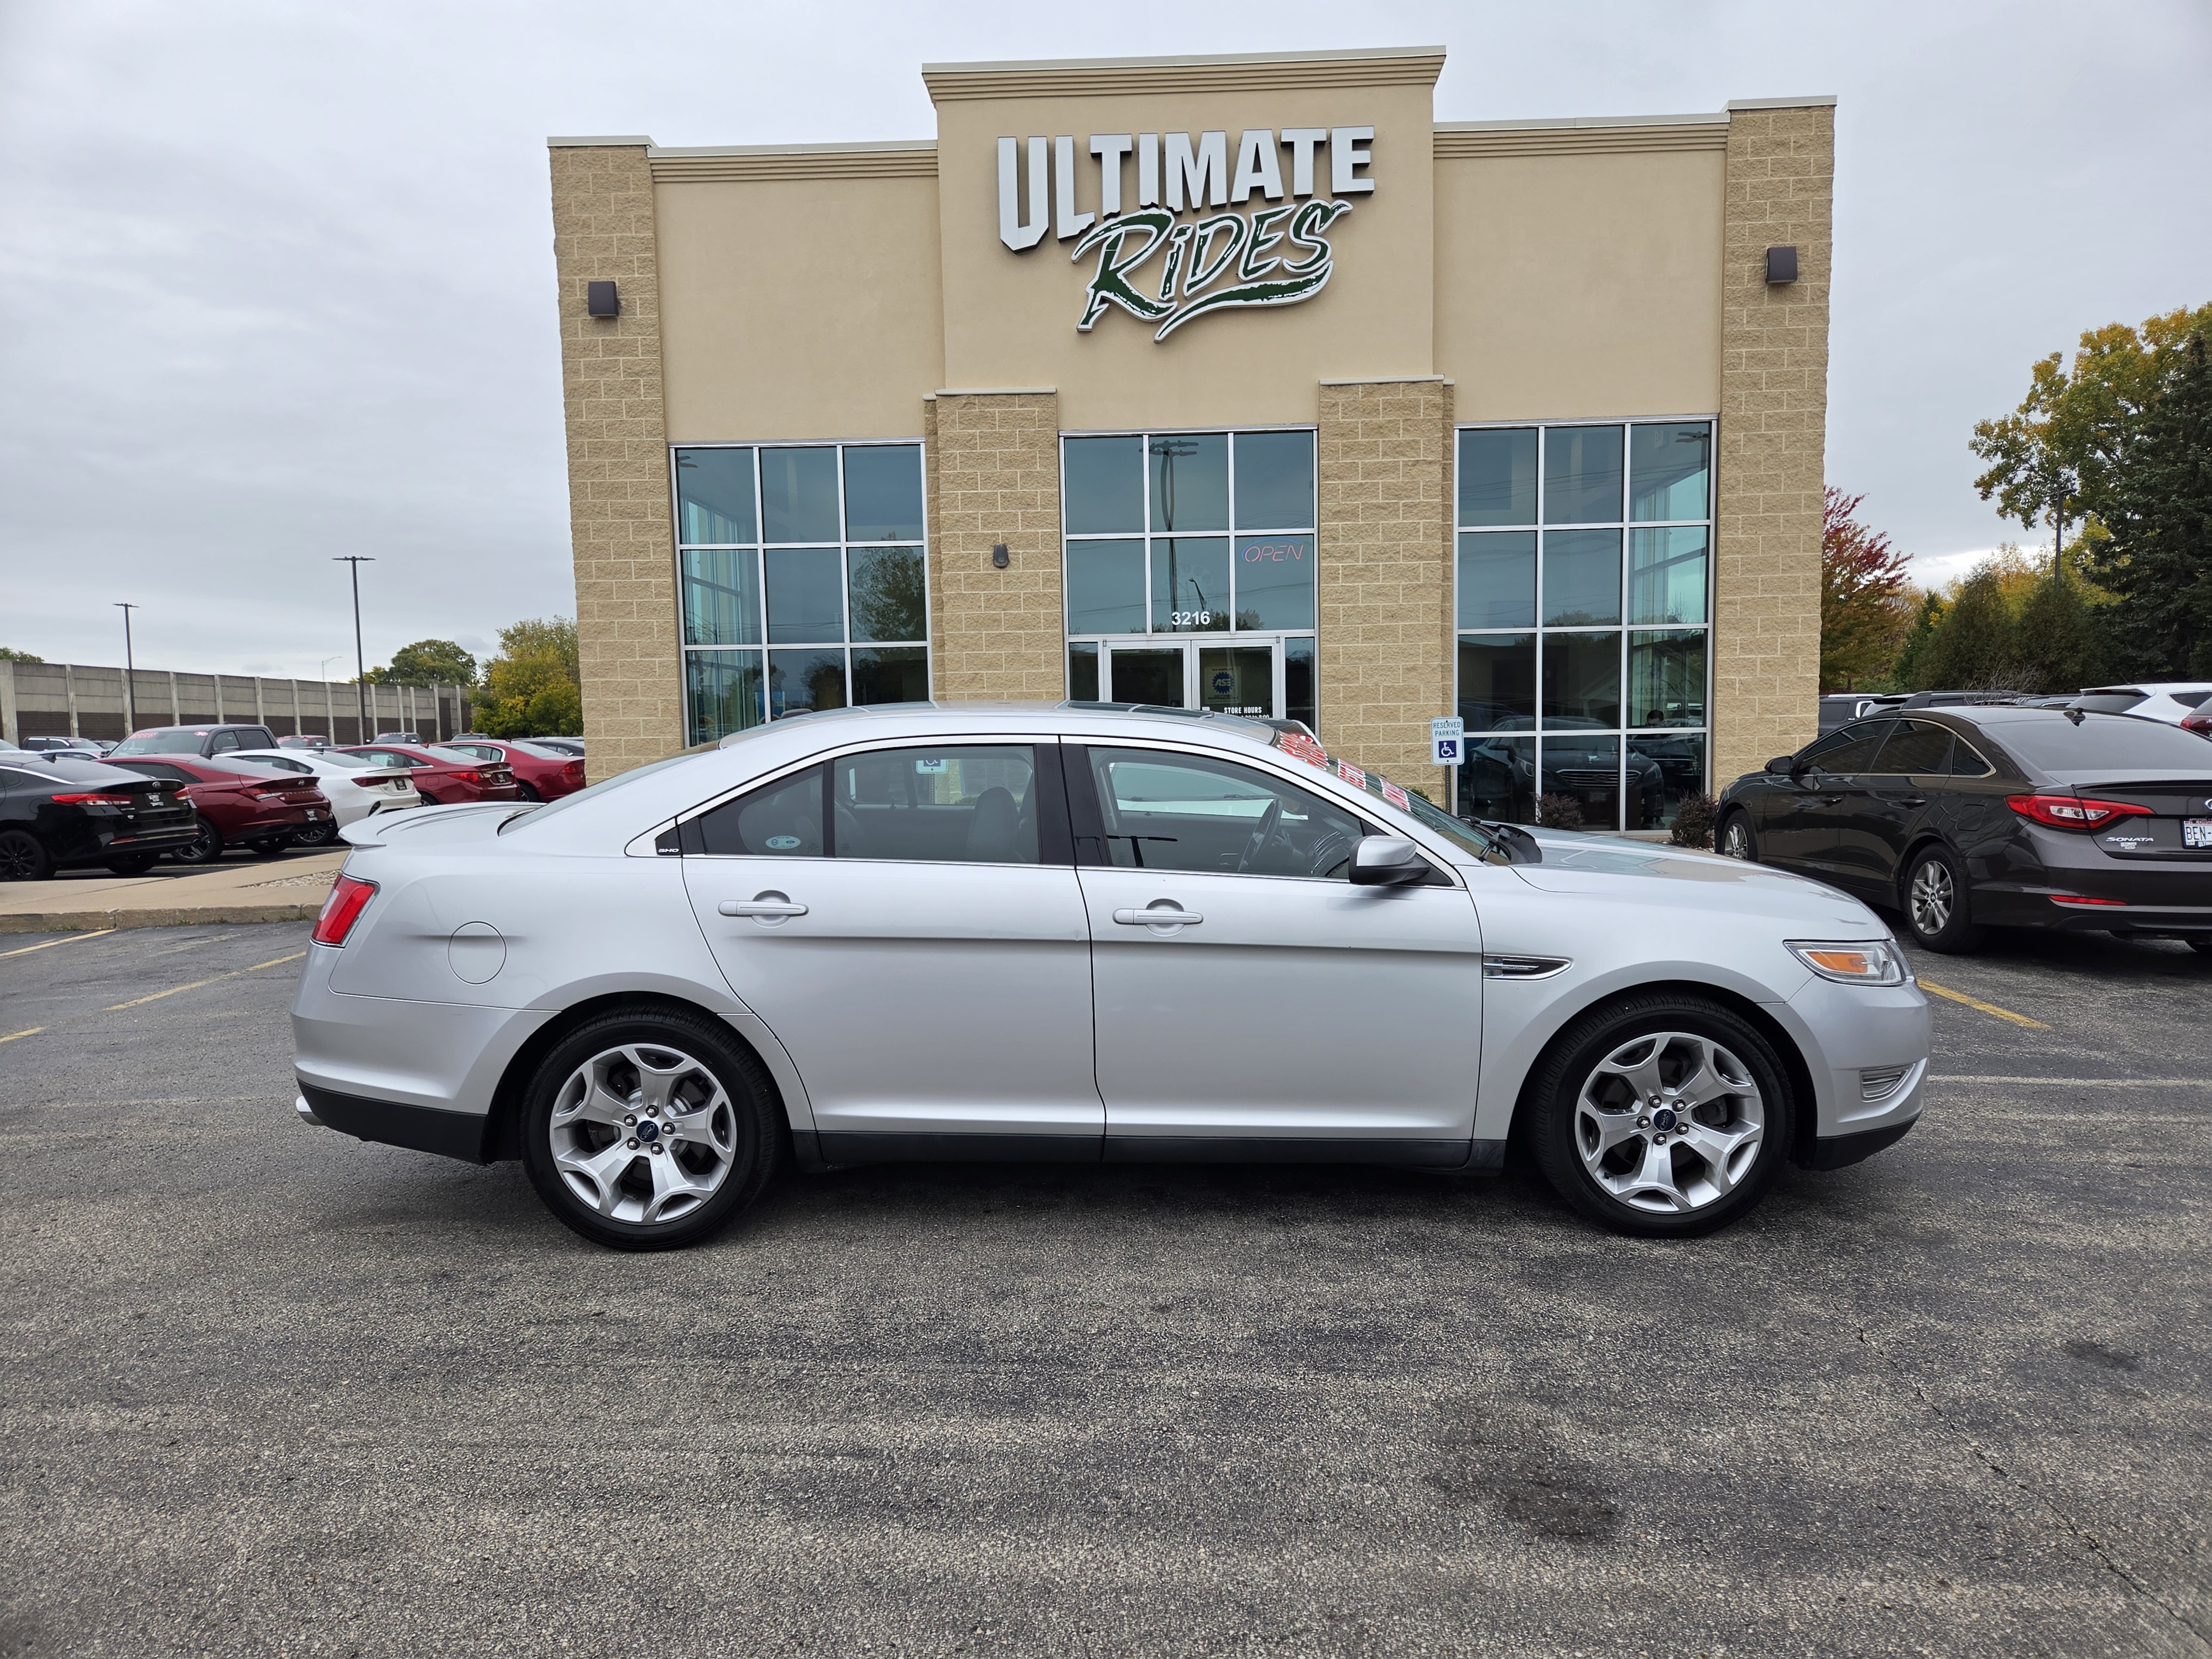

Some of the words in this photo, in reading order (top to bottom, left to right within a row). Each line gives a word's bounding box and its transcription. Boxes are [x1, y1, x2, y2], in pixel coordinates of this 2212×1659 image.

[998, 126, 1375, 254] ULTIMATE
[1245, 545, 1303, 562] OPEN
[1171, 611, 1211, 625] 3216
[1214, 679, 1231, 687] ASE
